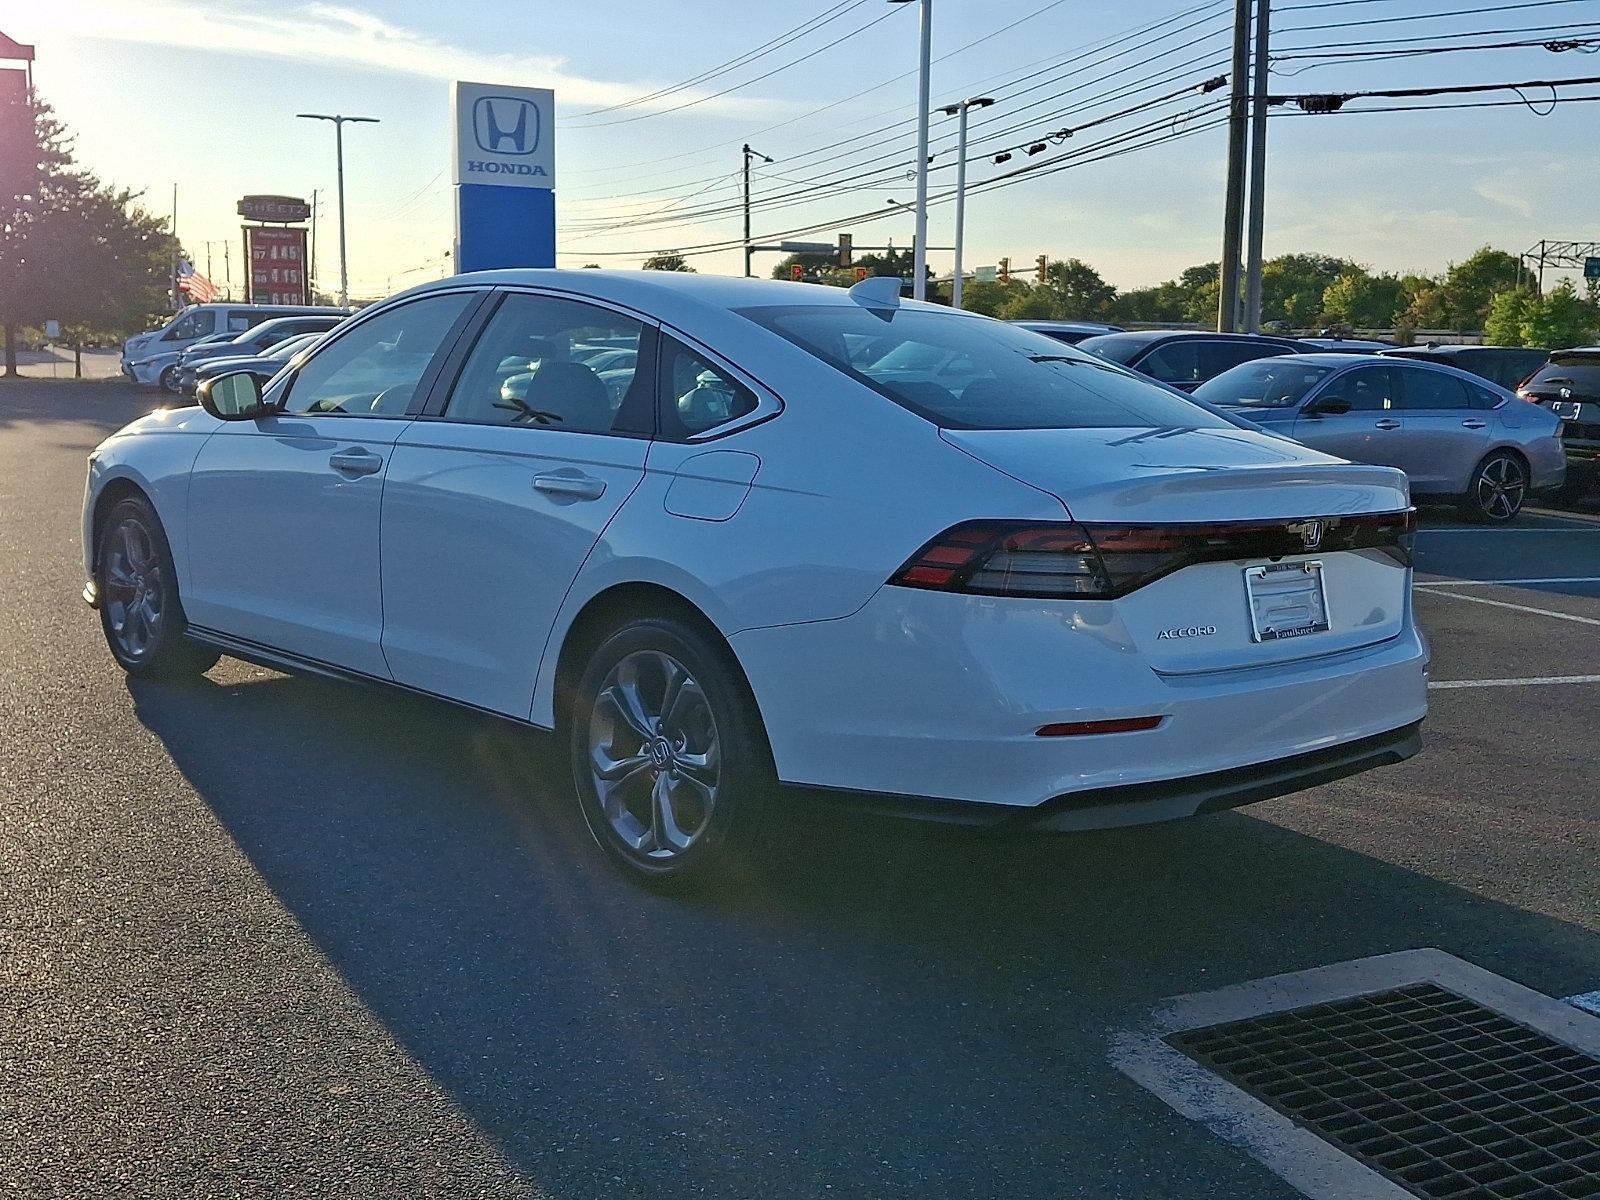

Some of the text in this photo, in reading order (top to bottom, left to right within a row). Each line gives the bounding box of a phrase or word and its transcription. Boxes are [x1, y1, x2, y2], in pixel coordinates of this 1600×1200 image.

[467, 161, 548, 176] HONDA
[1157, 626, 1217, 640] ACCORD
[1276, 627, 1315, 639] Faulkner
